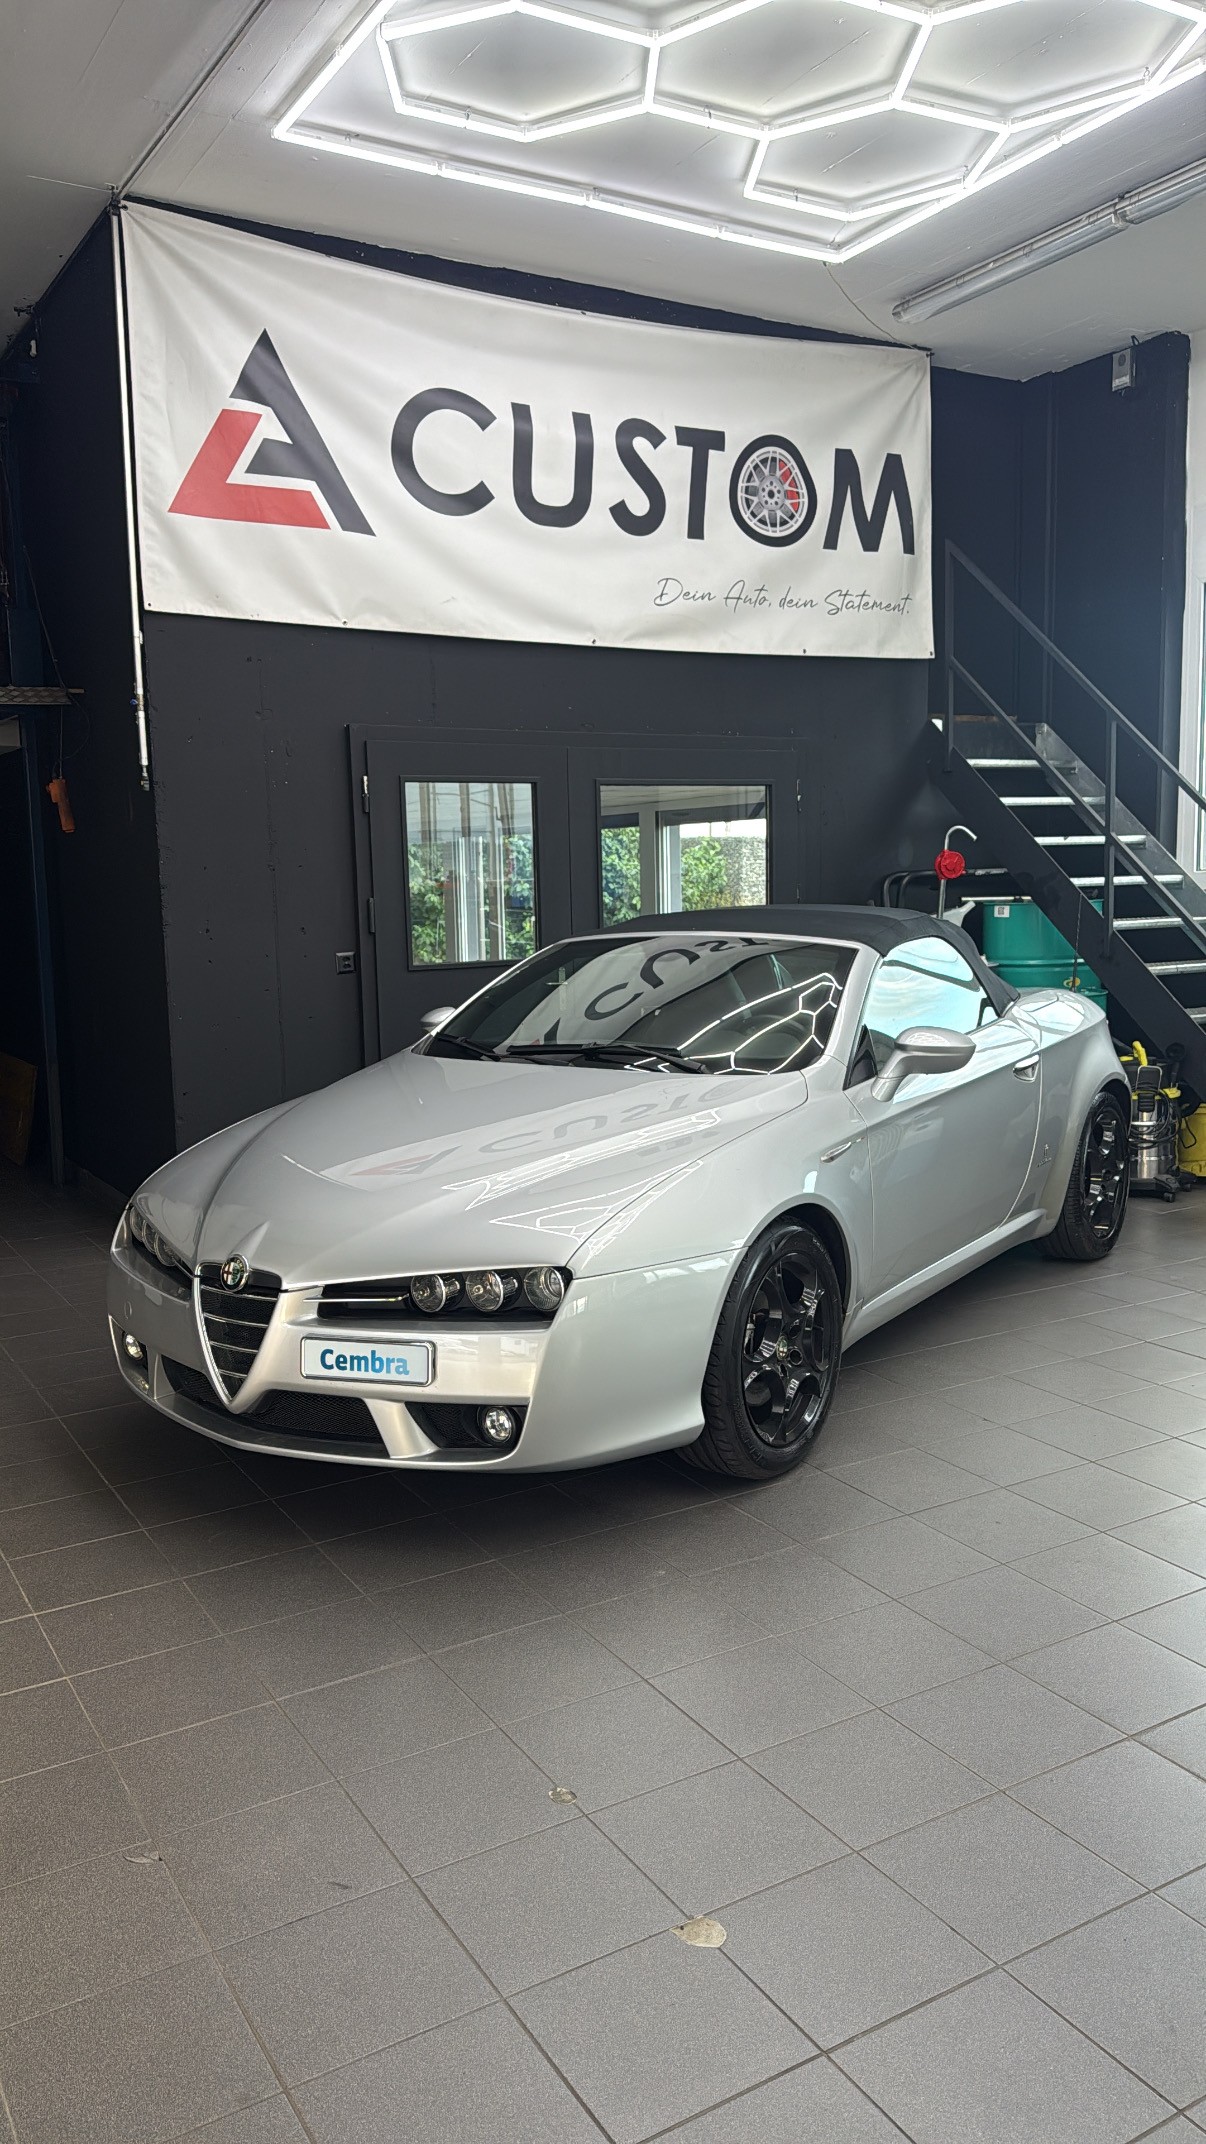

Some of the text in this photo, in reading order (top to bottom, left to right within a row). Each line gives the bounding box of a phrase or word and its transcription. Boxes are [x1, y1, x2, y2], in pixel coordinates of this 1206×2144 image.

[390, 387, 916, 556] CUSTOM
[653, 577, 913, 616] Dein Auto, dein Statement.
[320, 1348, 410, 1376] Cembra
